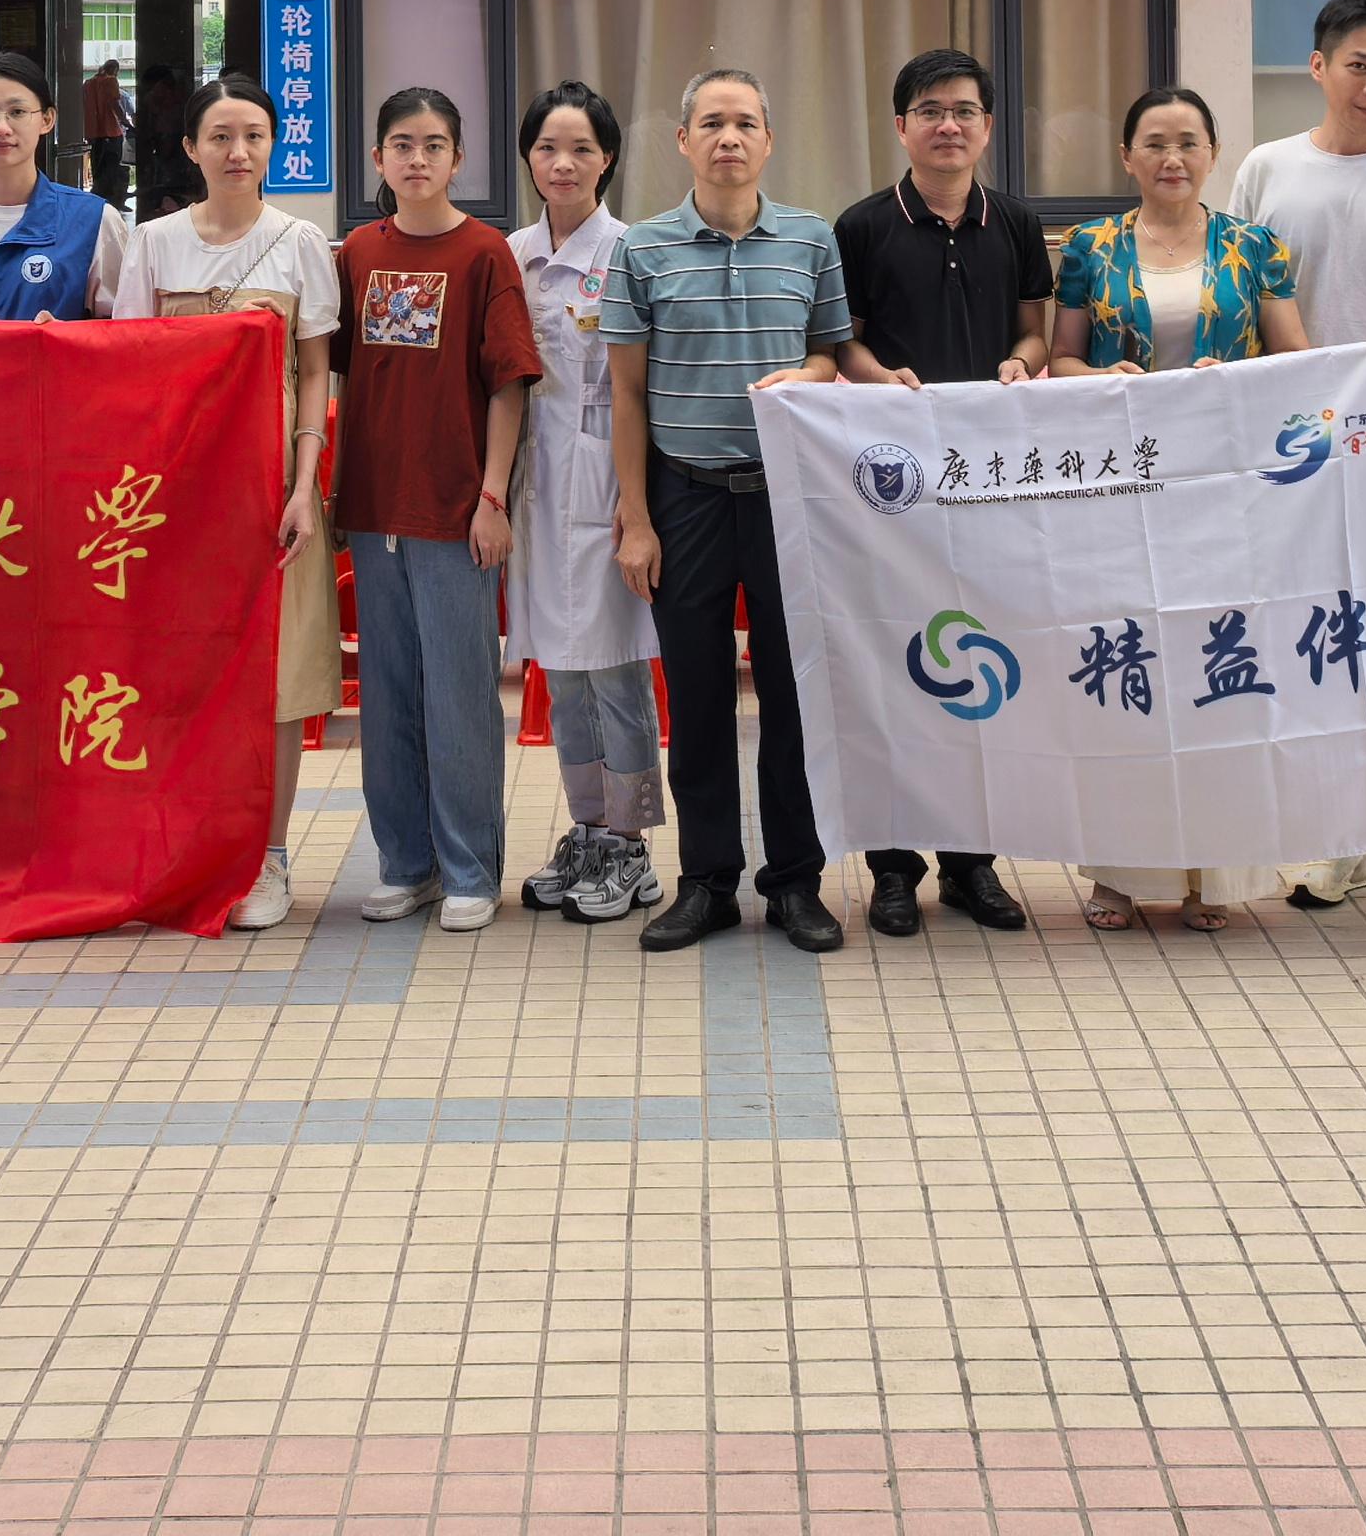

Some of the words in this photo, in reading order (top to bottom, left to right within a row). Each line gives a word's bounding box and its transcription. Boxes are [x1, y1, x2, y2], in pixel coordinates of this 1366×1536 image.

[280, 3, 314, 182] 轮椅停放处
[936, 493, 1009, 506] GUANGDONG
[1013, 487, 1106, 502] PHARMACEUTICAL
[1109, 481, 1166, 496] UNIVERSITY
